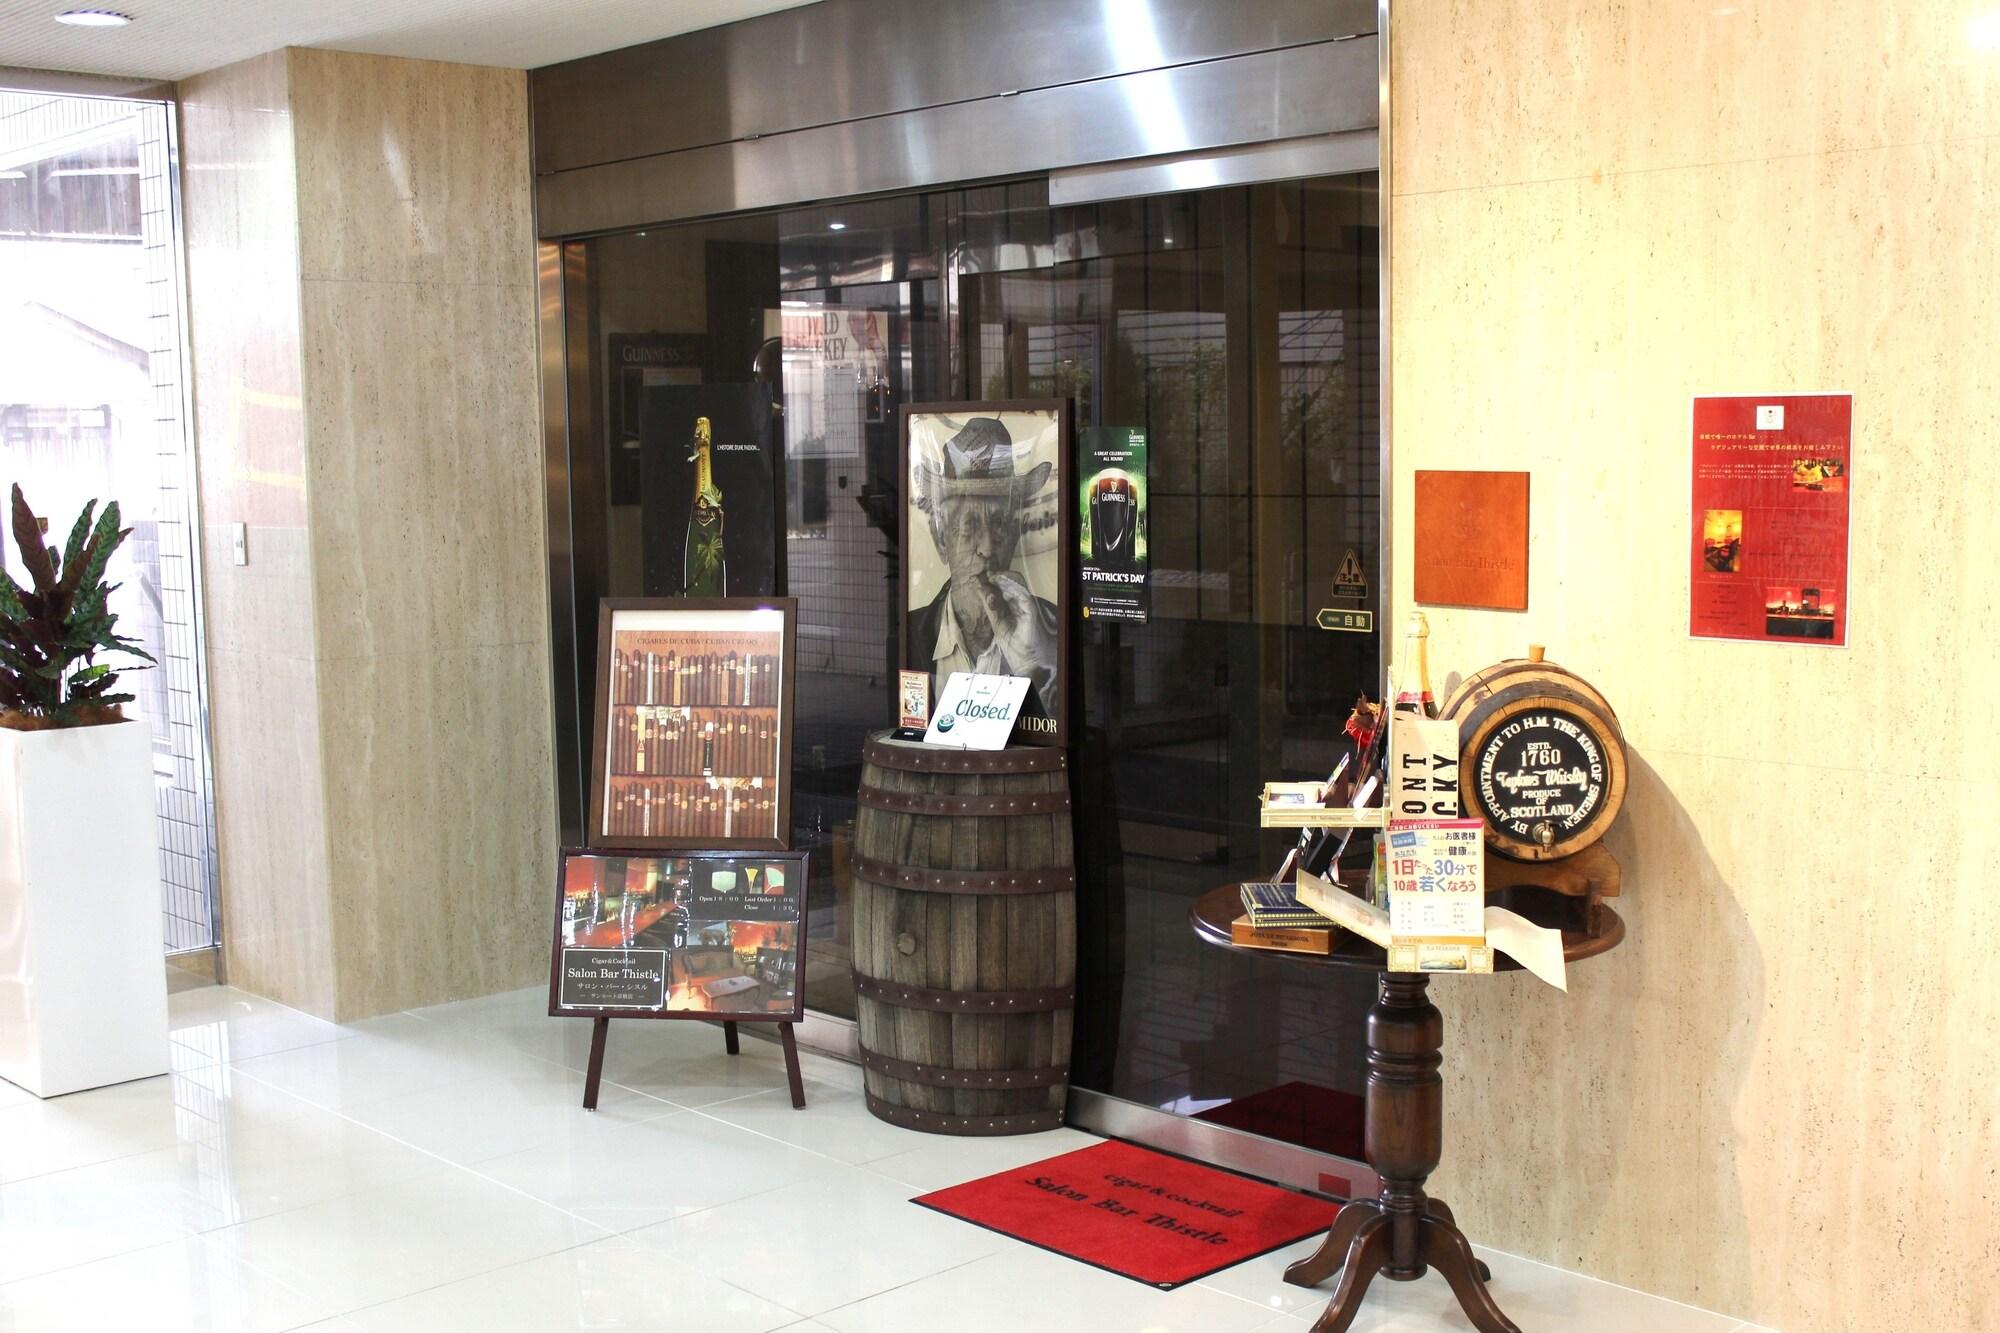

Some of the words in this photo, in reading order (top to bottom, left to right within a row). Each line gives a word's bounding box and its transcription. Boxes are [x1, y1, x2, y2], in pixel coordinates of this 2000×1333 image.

[807, 312, 839, 335] WLD
[622, 344, 681, 362] GUINNESS
[1101, 492, 1126, 503] GUINNESS
[1082, 571, 1091, 580] ST
[1092, 572, 1129, 582] PATRICK'S
[1130, 574, 1145, 583] DAY
[1344, 614, 1366, 627] 自動
[1501, 723, 1521, 739] TO
[1523, 716, 1550, 730] H.M.
[1552, 716, 1581, 739] THE
[1527, 742, 1552, 750] ESTD.
[1576, 733, 1600, 764] KING
[1521, 749, 1561, 767] 1760
[1481, 736, 1511, 823] APPOINTMENT
[1590, 763, 1602, 782] OF
[1522, 788, 1562, 799] PRODUCE
[1535, 797, 1548, 805] OF
[1510, 804, 1575, 818] SCOTLAND
[1562, 783, 1600, 830] SWEDEN
[1510, 821, 1529, 835] BY
[1392, 859, 1477, 876] 1日たった30分で
[1393, 876, 1477, 893] 10歳若くなろう
[568, 967, 597, 978] Salon
[600, 968, 620, 979] Bar
[621, 969, 659, 980] Thistle
[1025, 1176, 1088, 1201] Salon
[1091, 1198, 1139, 1218] Bar
[1144, 1213, 1229, 1246] Thistle
[1167, 1193, 1245, 1218] cocktail
